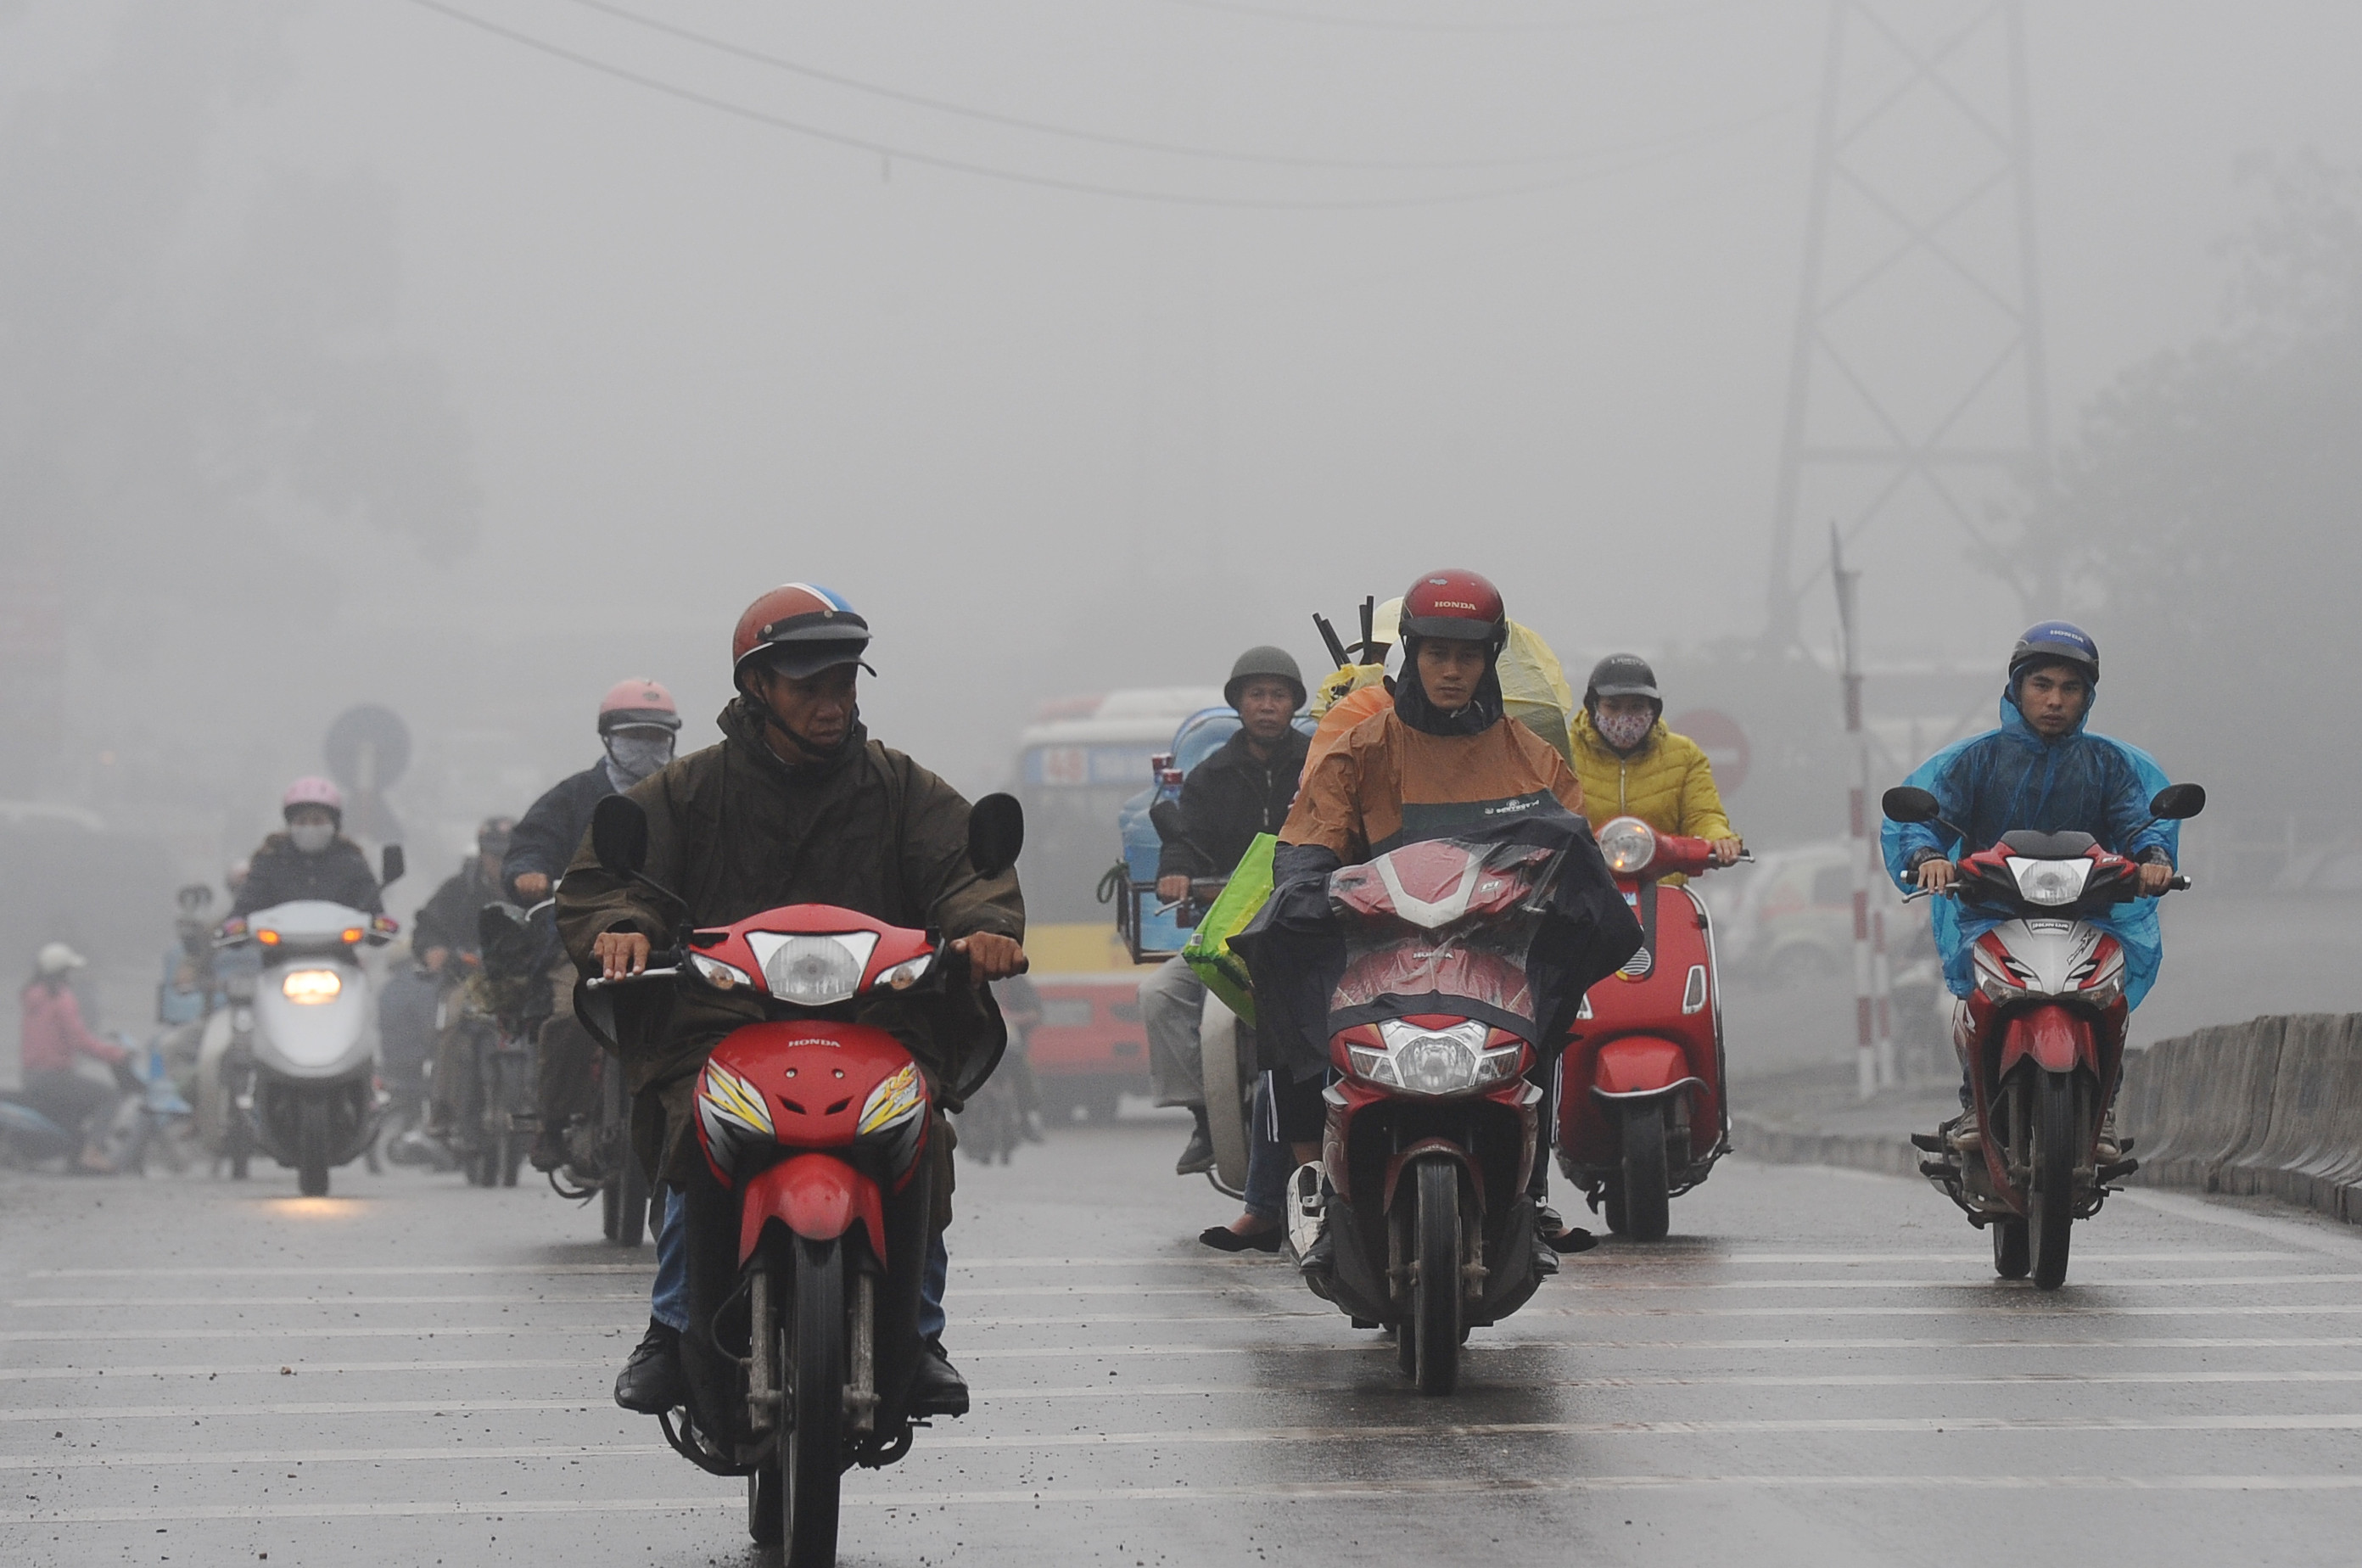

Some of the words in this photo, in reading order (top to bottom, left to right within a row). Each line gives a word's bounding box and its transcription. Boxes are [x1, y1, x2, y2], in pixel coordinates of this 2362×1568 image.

[1435, 601, 1476, 611] HONDA
[2050, 630, 2084, 643] HONDA
[788, 1039, 841, 1048] HONDA
